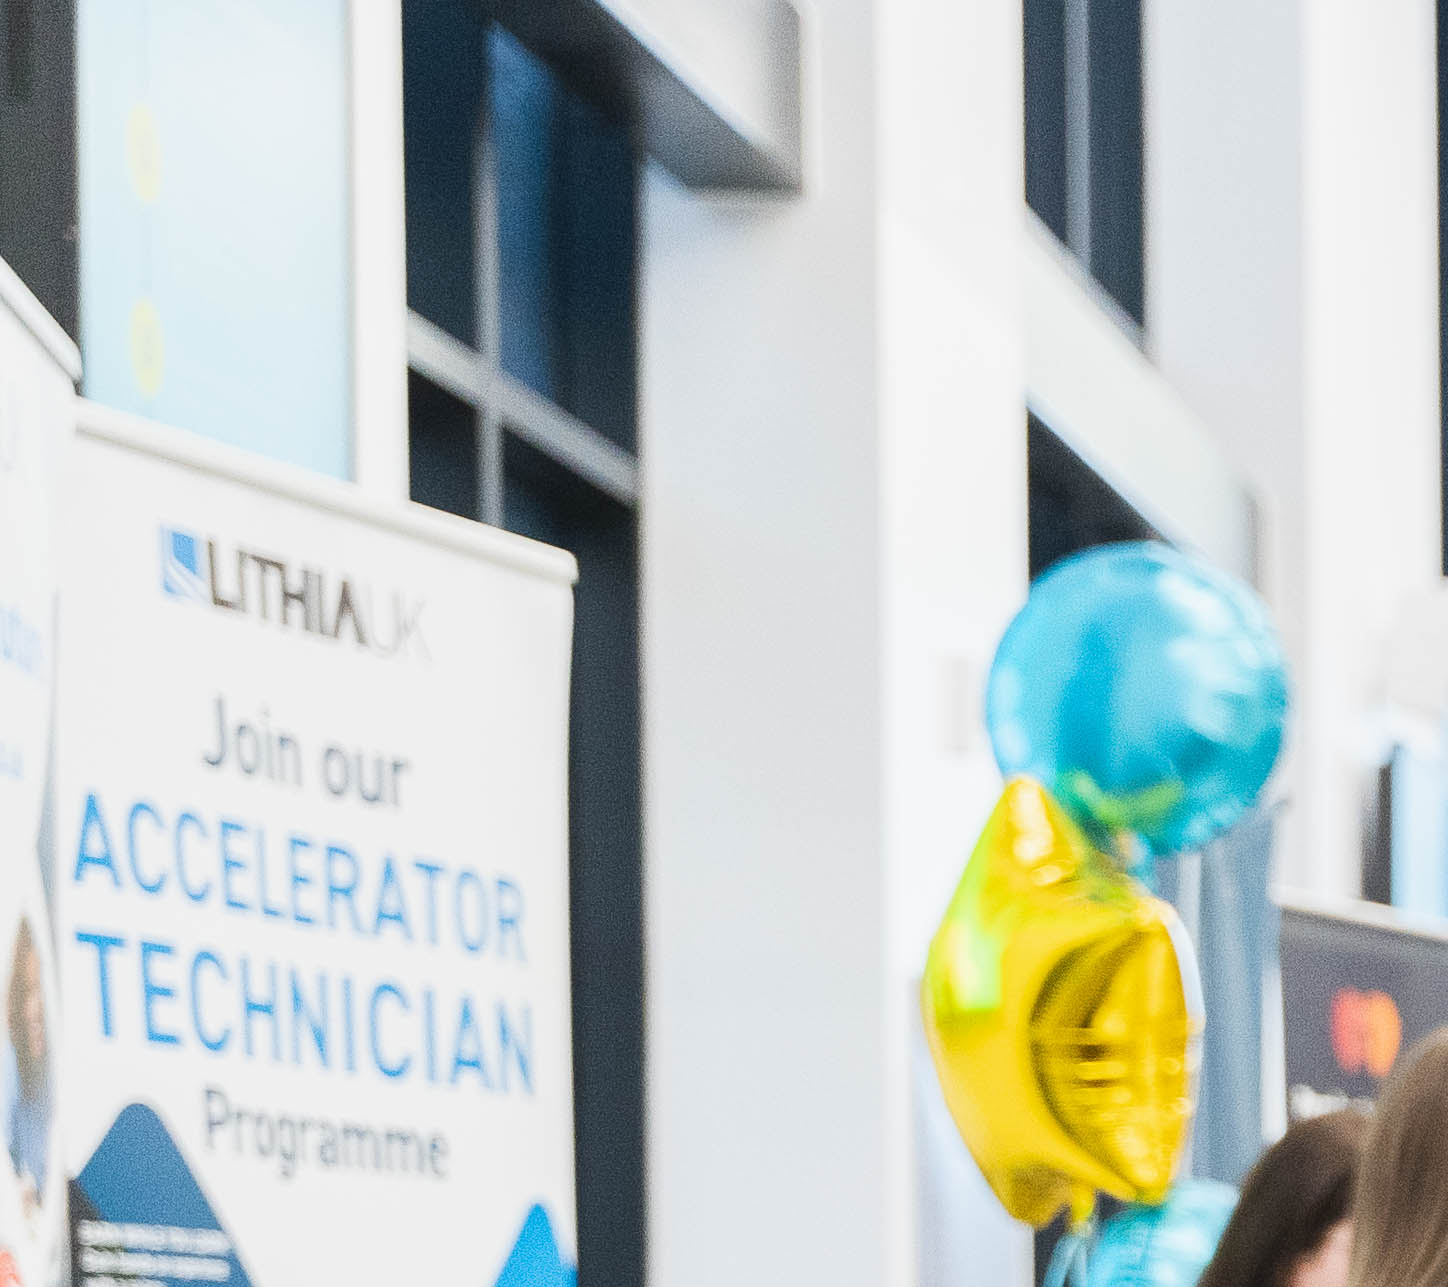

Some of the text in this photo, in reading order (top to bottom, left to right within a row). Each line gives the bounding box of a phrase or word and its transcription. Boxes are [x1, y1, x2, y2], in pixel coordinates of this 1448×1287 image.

[203, 697, 410, 806] Join our
[74, 792, 528, 966] ACCELERATOR
[74, 930, 536, 1095] TECHNICIAN
[205, 1087, 450, 1178] Programme
